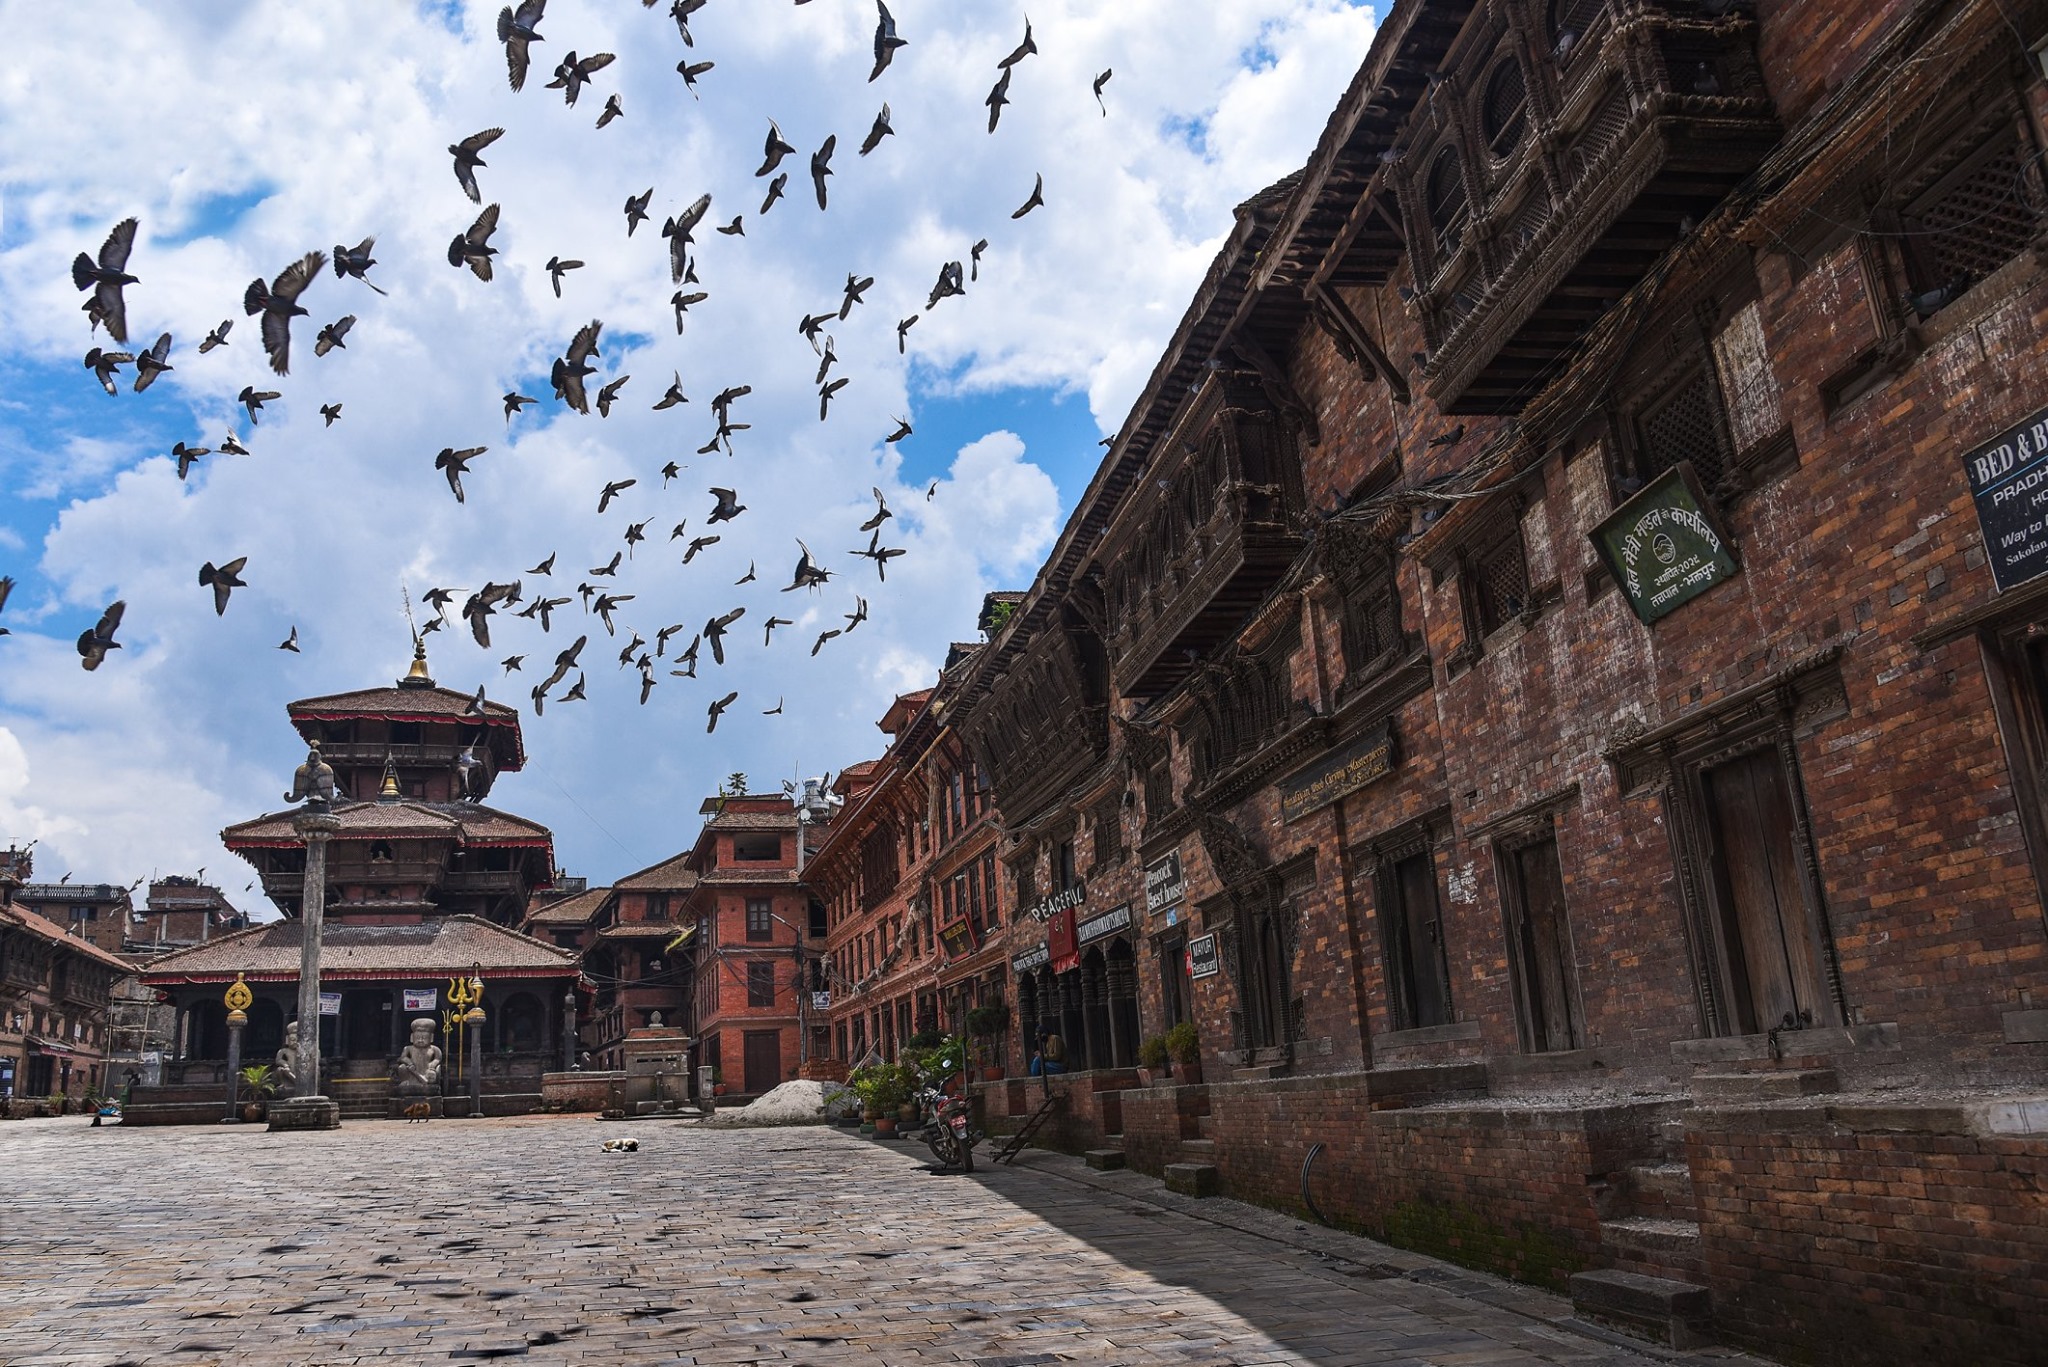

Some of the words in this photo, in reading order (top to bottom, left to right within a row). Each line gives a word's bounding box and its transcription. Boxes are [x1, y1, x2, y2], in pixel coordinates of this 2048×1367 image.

[1974, 444, 2014, 485] BED
[2018, 433, 2032, 461] &
[1670, 506, 1721, 554] कार्यालय
[2001, 528, 2027, 549] Way
[2029, 521, 2042, 534] to
[1682, 560, 1716, 586] भक्तपुर
[1147, 859, 1172, 888] Peacock
[1031, 886, 1084, 922] PEACEFUL
[1164, 883, 1182, 902] house
[1192, 939, 1212, 957] MAYUR
[1192, 957, 1217, 974] Restaurant
